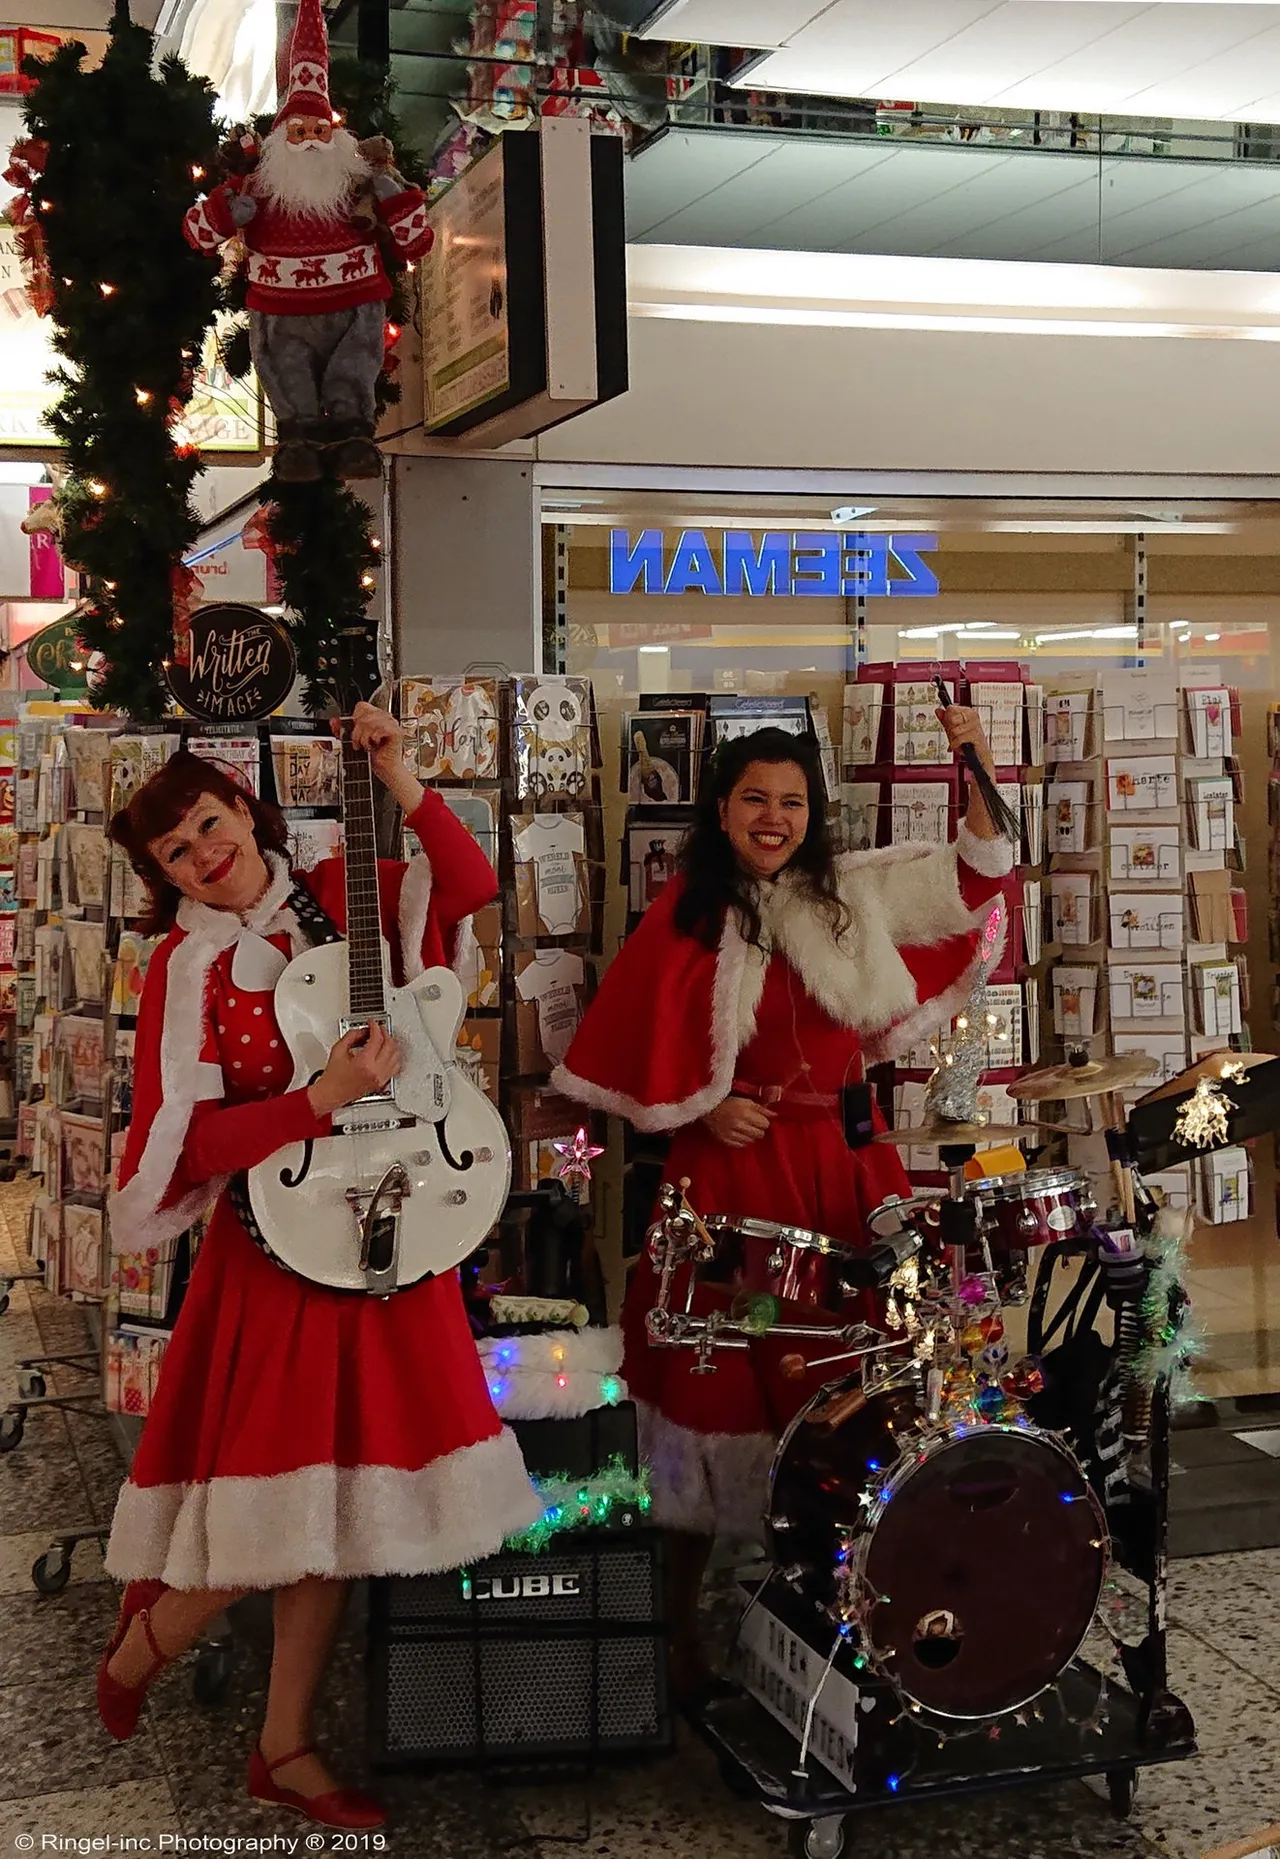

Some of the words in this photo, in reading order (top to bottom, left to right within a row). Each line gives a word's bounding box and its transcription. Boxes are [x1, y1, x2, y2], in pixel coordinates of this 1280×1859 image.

[246, 628, 261, 638] THE
[189, 627, 272, 693] Written
[203, 689, 257, 717] IMAGE
[290, 762, 311, 777] DAY
